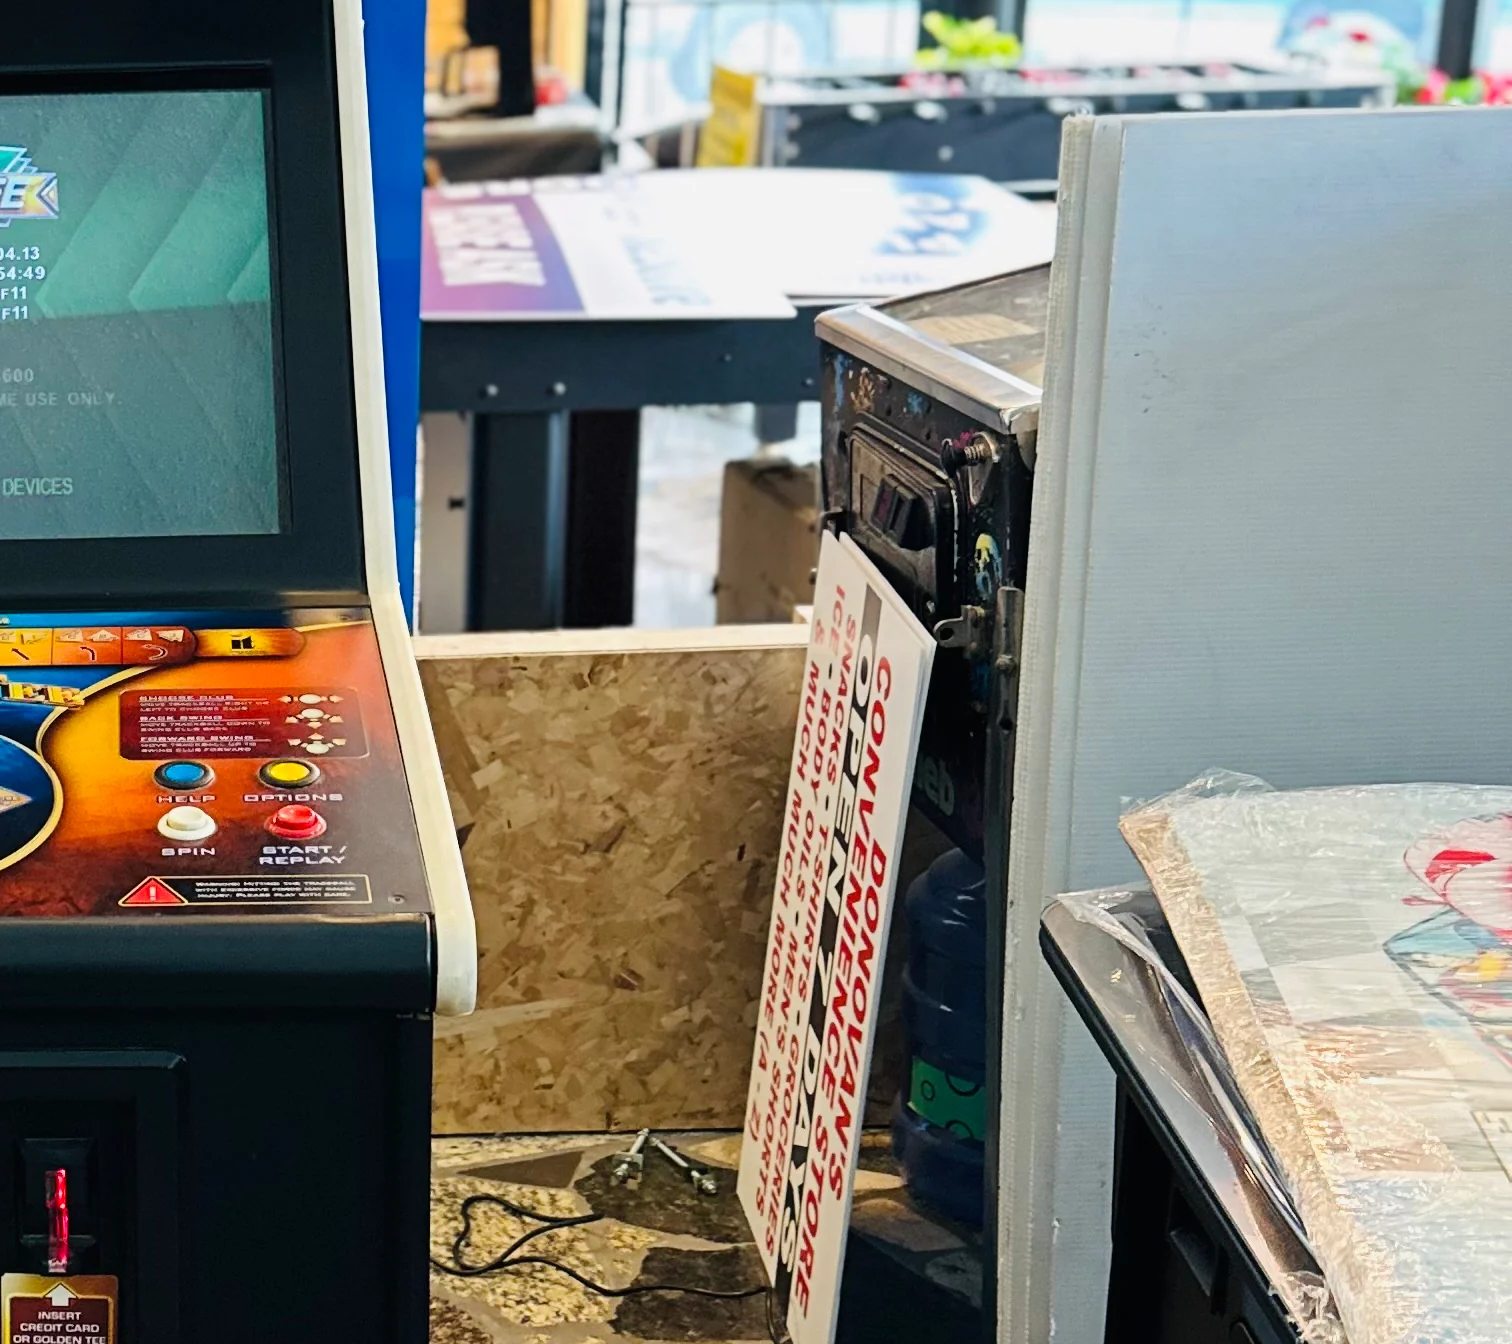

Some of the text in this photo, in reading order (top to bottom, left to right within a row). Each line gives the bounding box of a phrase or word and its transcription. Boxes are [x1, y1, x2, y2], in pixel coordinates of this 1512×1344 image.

[2, 368, 34, 383] 600
[3, 477, 73, 496] DEVICES
[157, 794, 216, 803] HELP
[244, 793, 343, 802] OPTIONS
[263, 845, 332, 855] START
[765, 660, 820, 1029] MUCH MUCH MORE
[161, 847, 216, 856] SPIN
[259, 856, 346, 865] REPLAY
[756, 584, 846, 1216] ICE BODY OILS MEN'S SHORTS
[765, 613, 856, 1256] SNACKS T-SHIRTS GROCERIES
[780, 633, 873, 1273] OPEN 7 DAYS
[795, 656, 892, 1320] CONVENIENCE STORE
[828, 839, 887, 1200] DONOVAN'S
[38, 1312, 82, 1321] INSERT
[20, 1323, 100, 1333] CREDIT CARD
[13, 1335, 106, 1344] OR GOLDEN TEE
